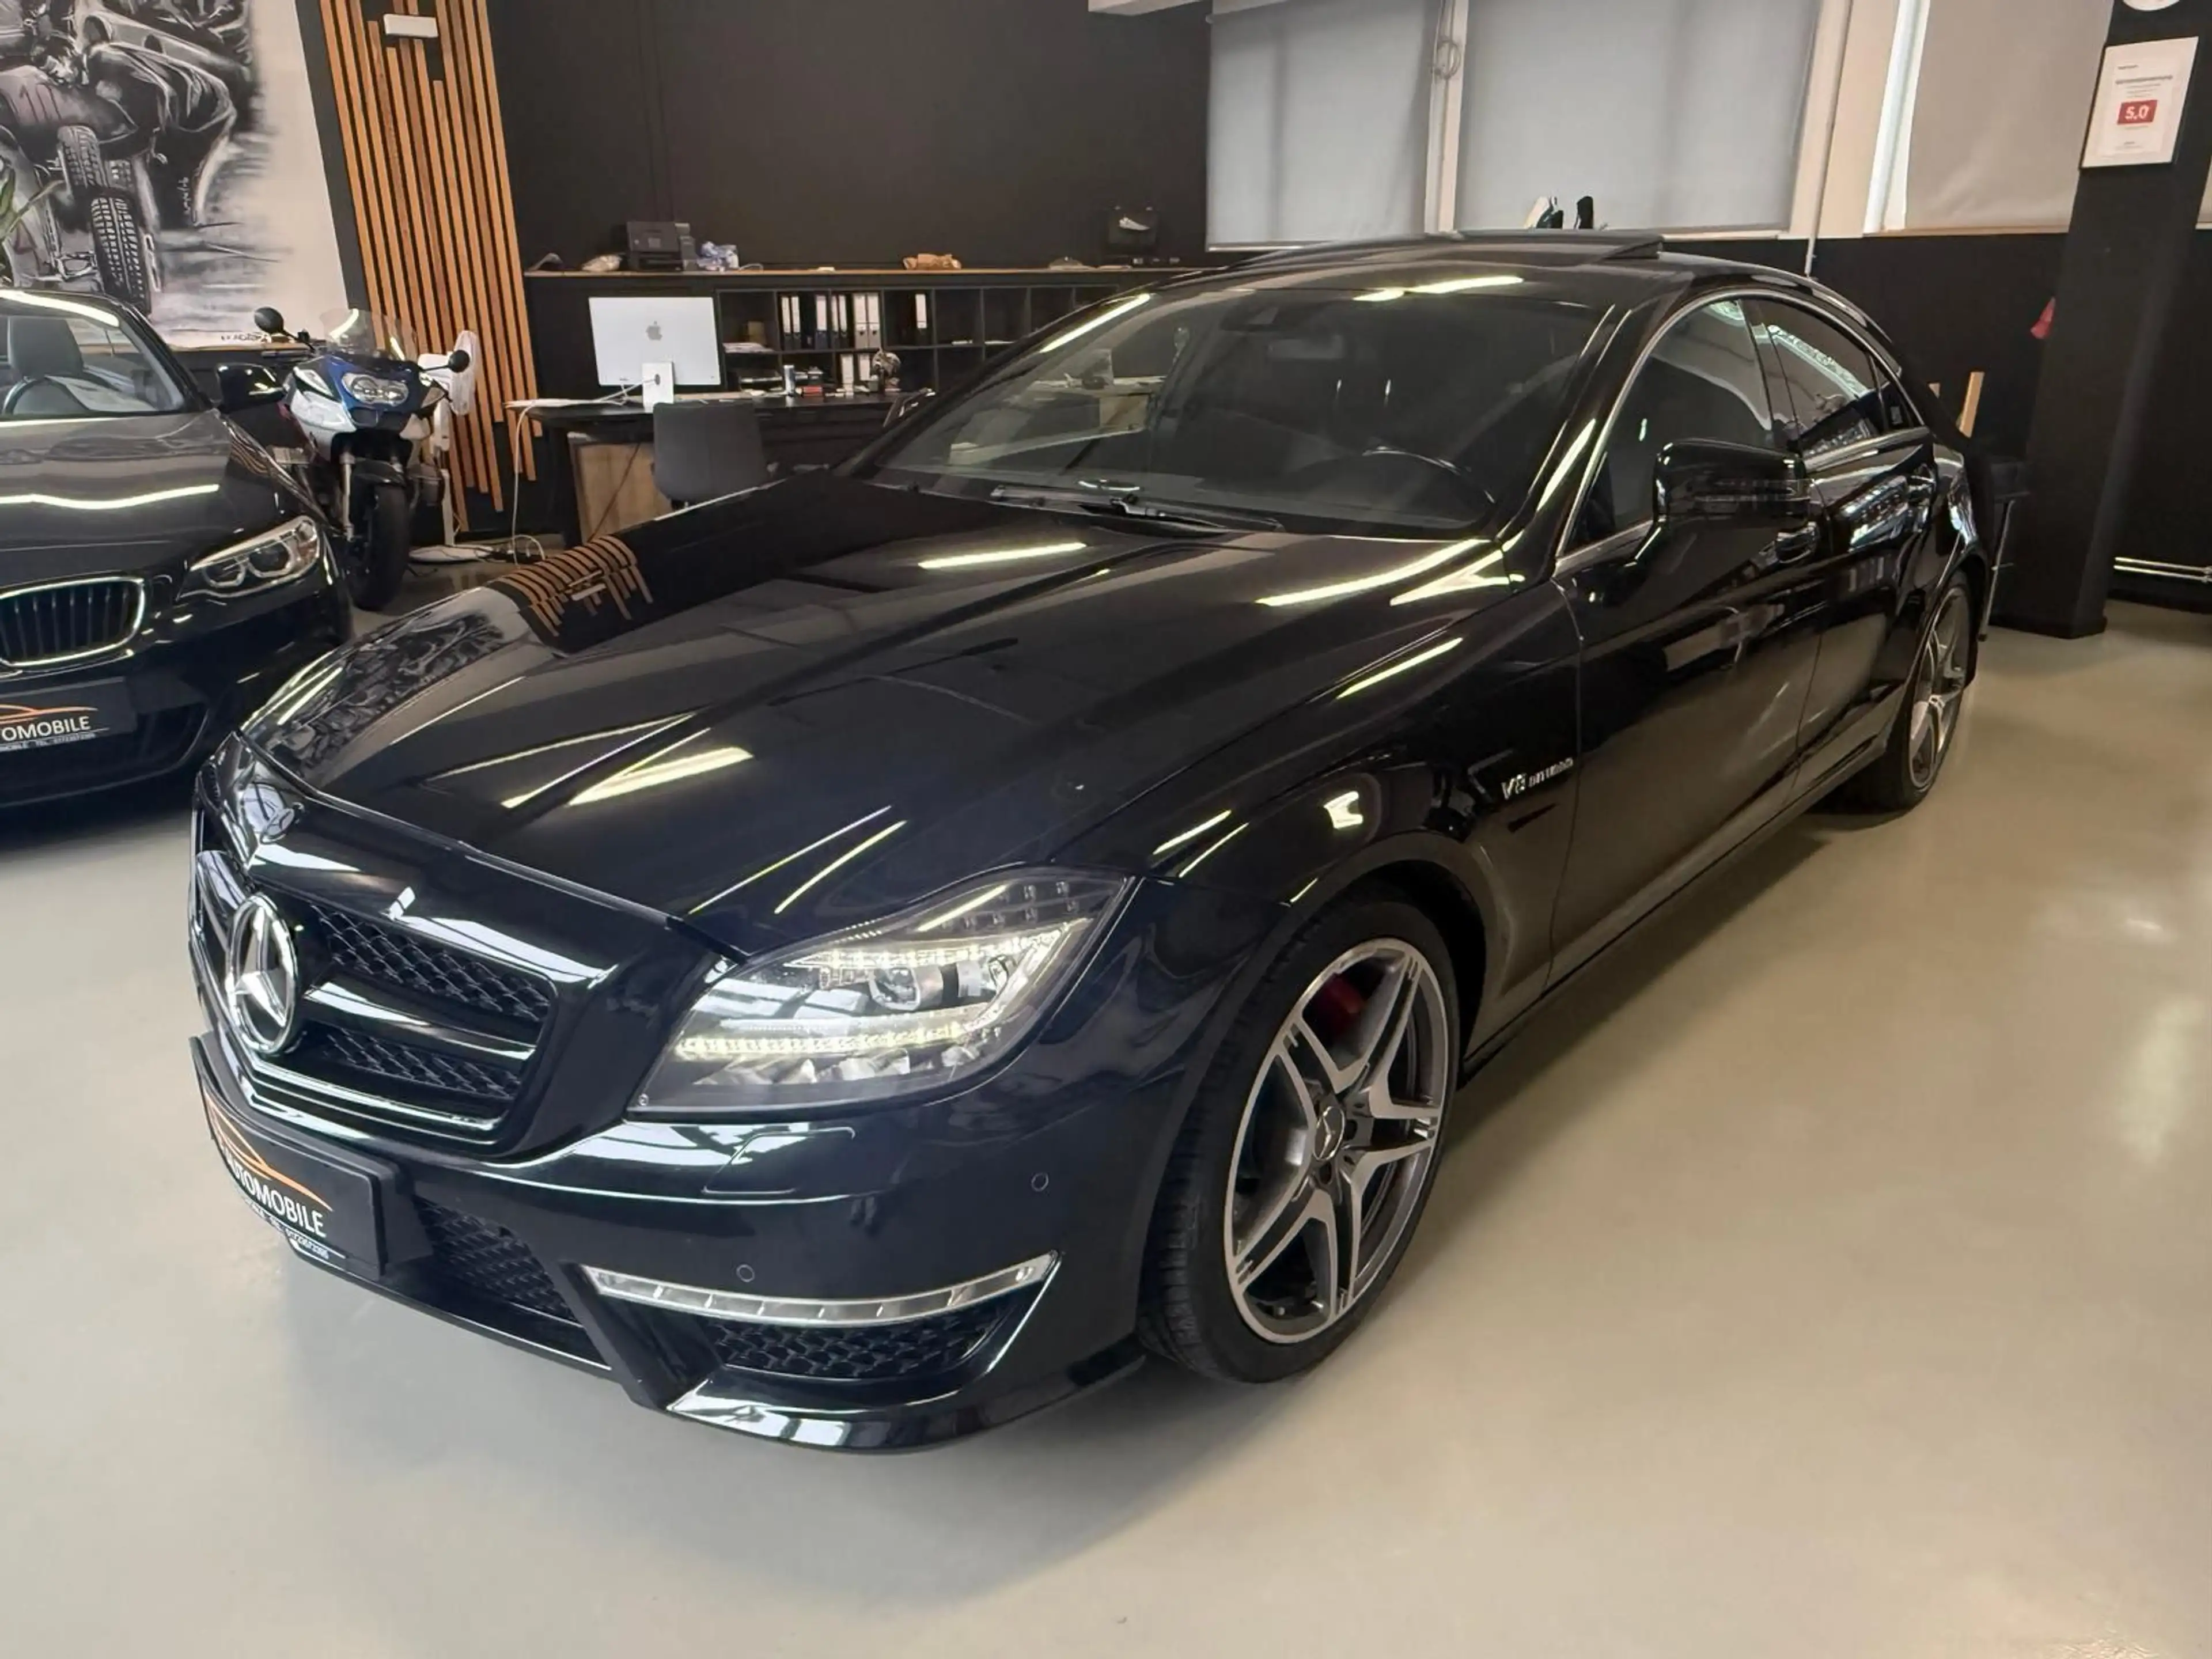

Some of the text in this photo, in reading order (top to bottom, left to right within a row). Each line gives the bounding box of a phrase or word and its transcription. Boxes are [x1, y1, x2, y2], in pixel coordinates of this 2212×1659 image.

[2124, 104, 2149, 120] 5.0
[1, 715, 91, 742] OMOBILE
[1501, 772, 1527, 800] V8
